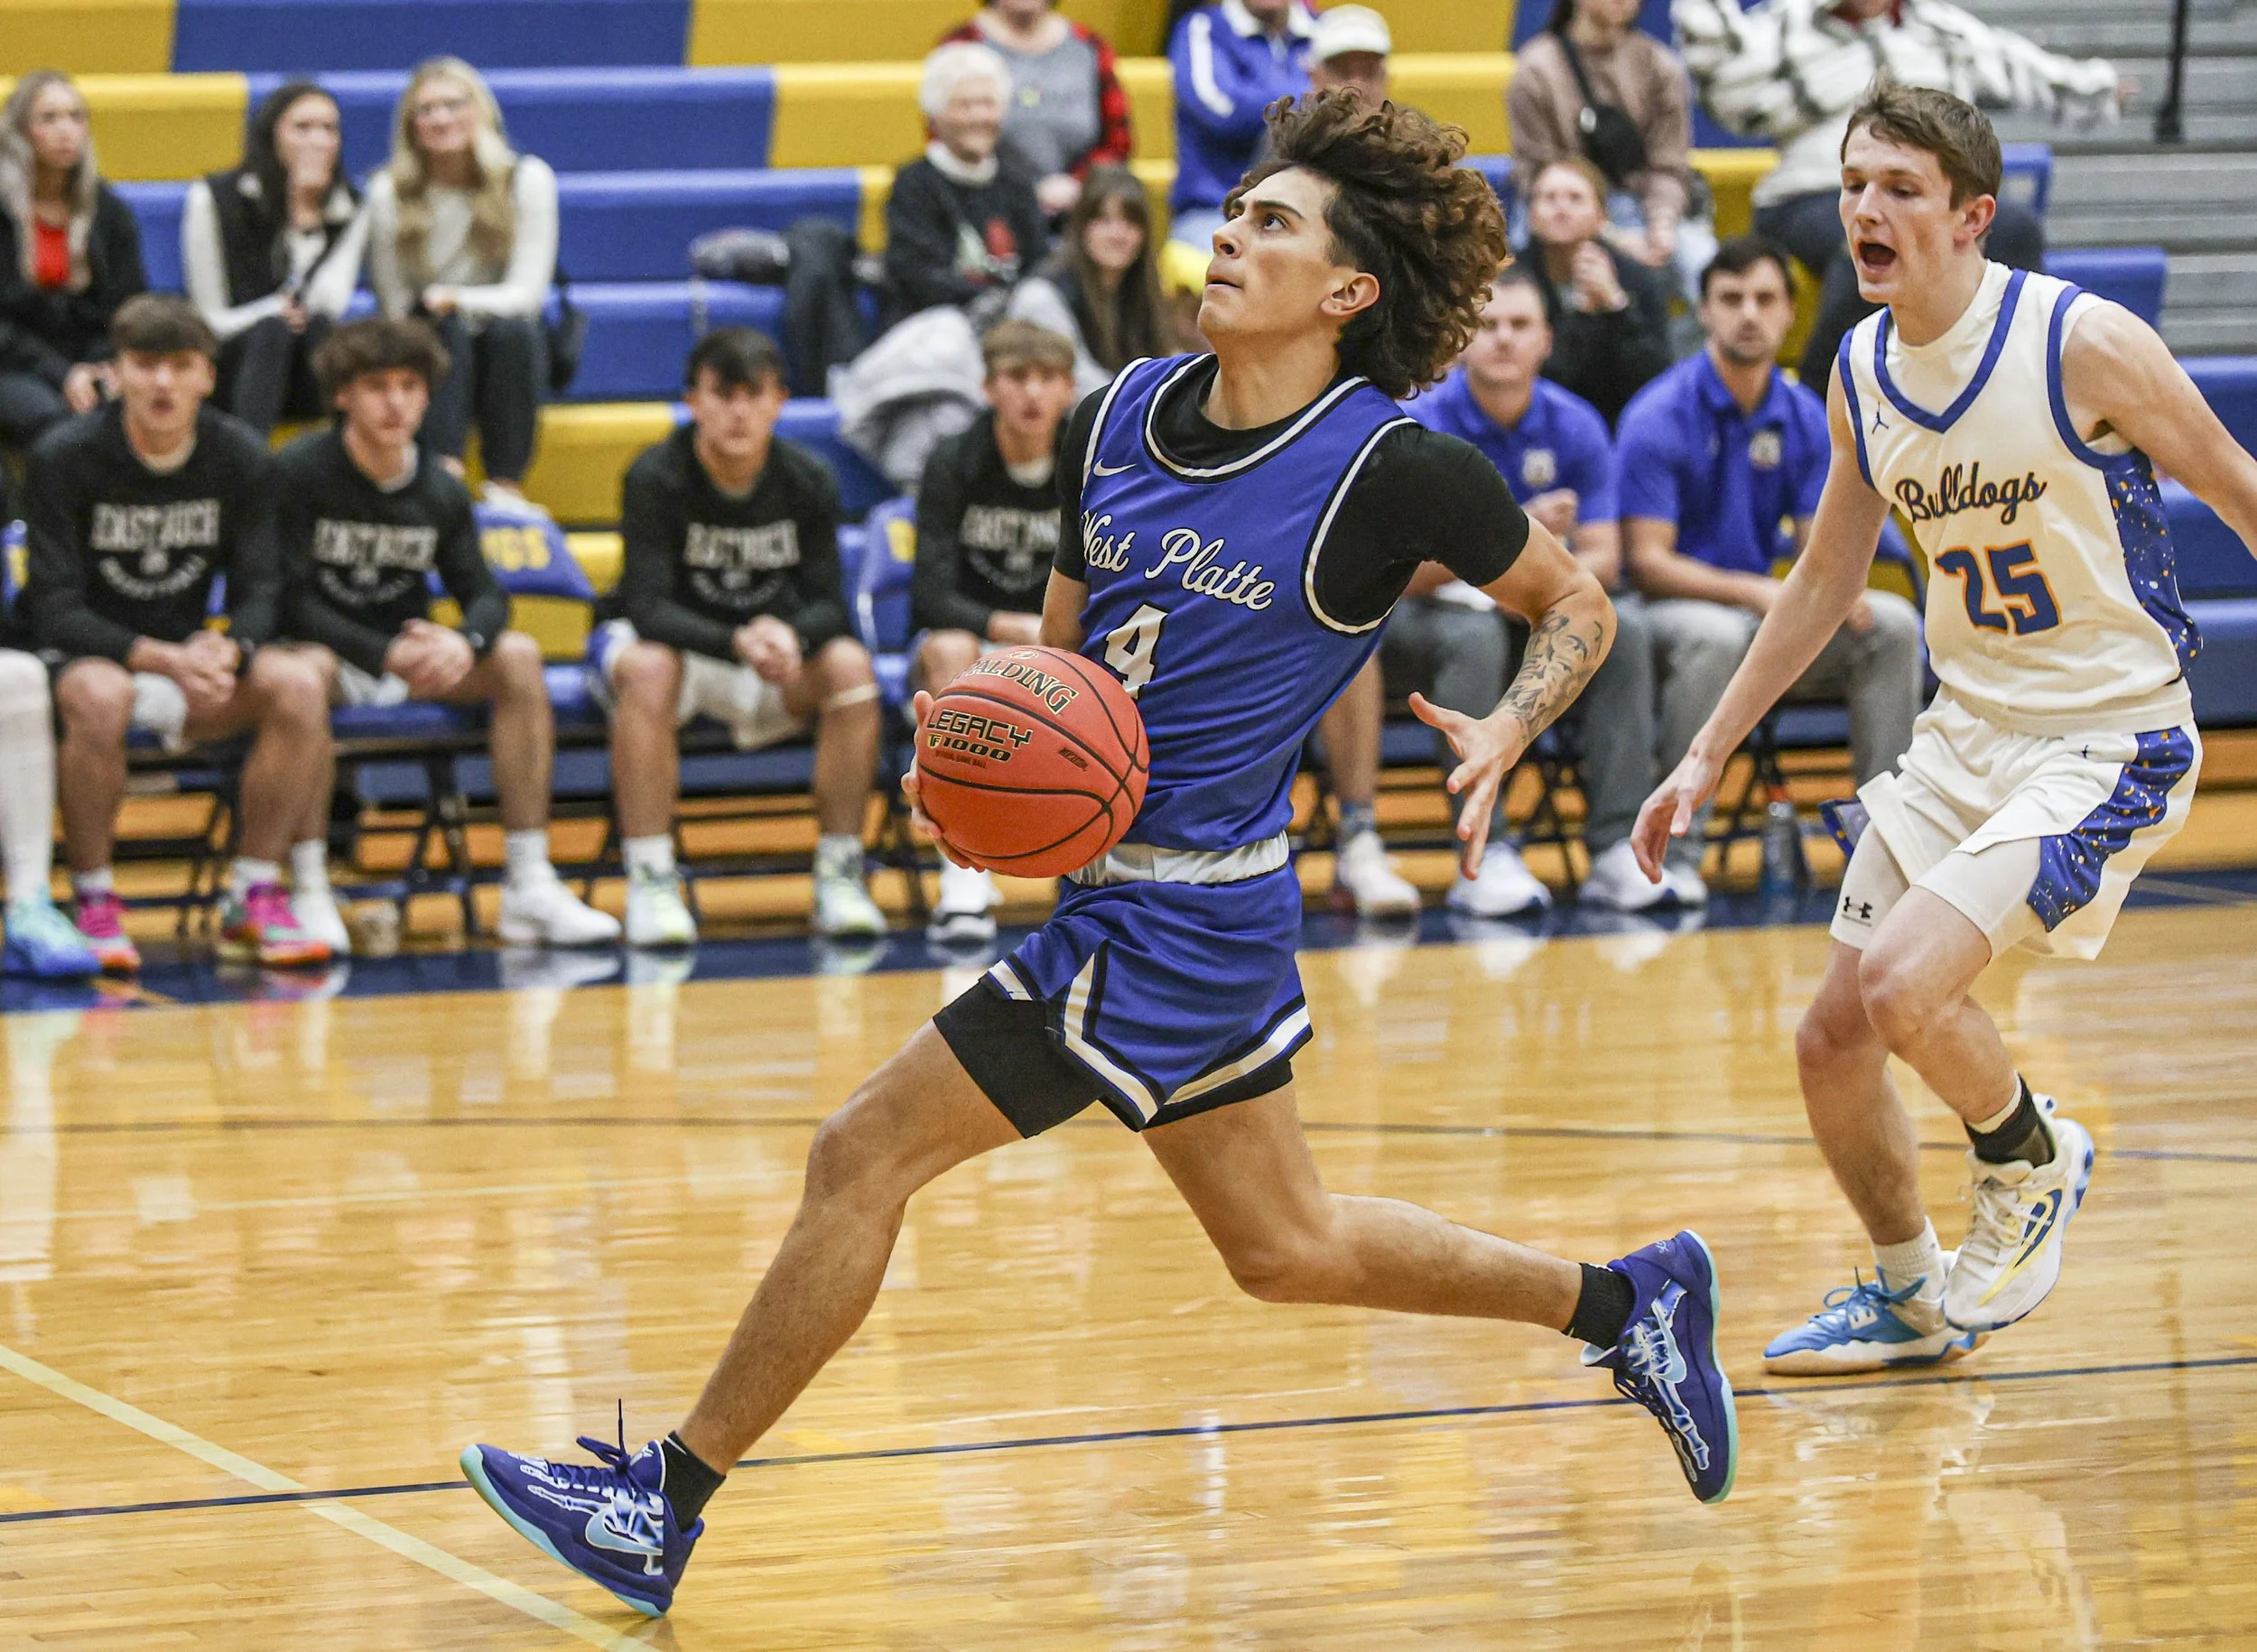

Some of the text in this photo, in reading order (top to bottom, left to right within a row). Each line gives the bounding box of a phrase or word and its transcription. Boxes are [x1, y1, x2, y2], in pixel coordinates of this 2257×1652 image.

[1896, 461, 2048, 525] Bulldogs
[1082, 508, 1137, 572] West
[1144, 527, 1277, 611] Platte
[1934, 538, 2063, 636] 25
[957, 658, 1080, 715] ALDING
[1103, 600, 1169, 701] 4
[926, 709, 1034, 750] LEGACY
